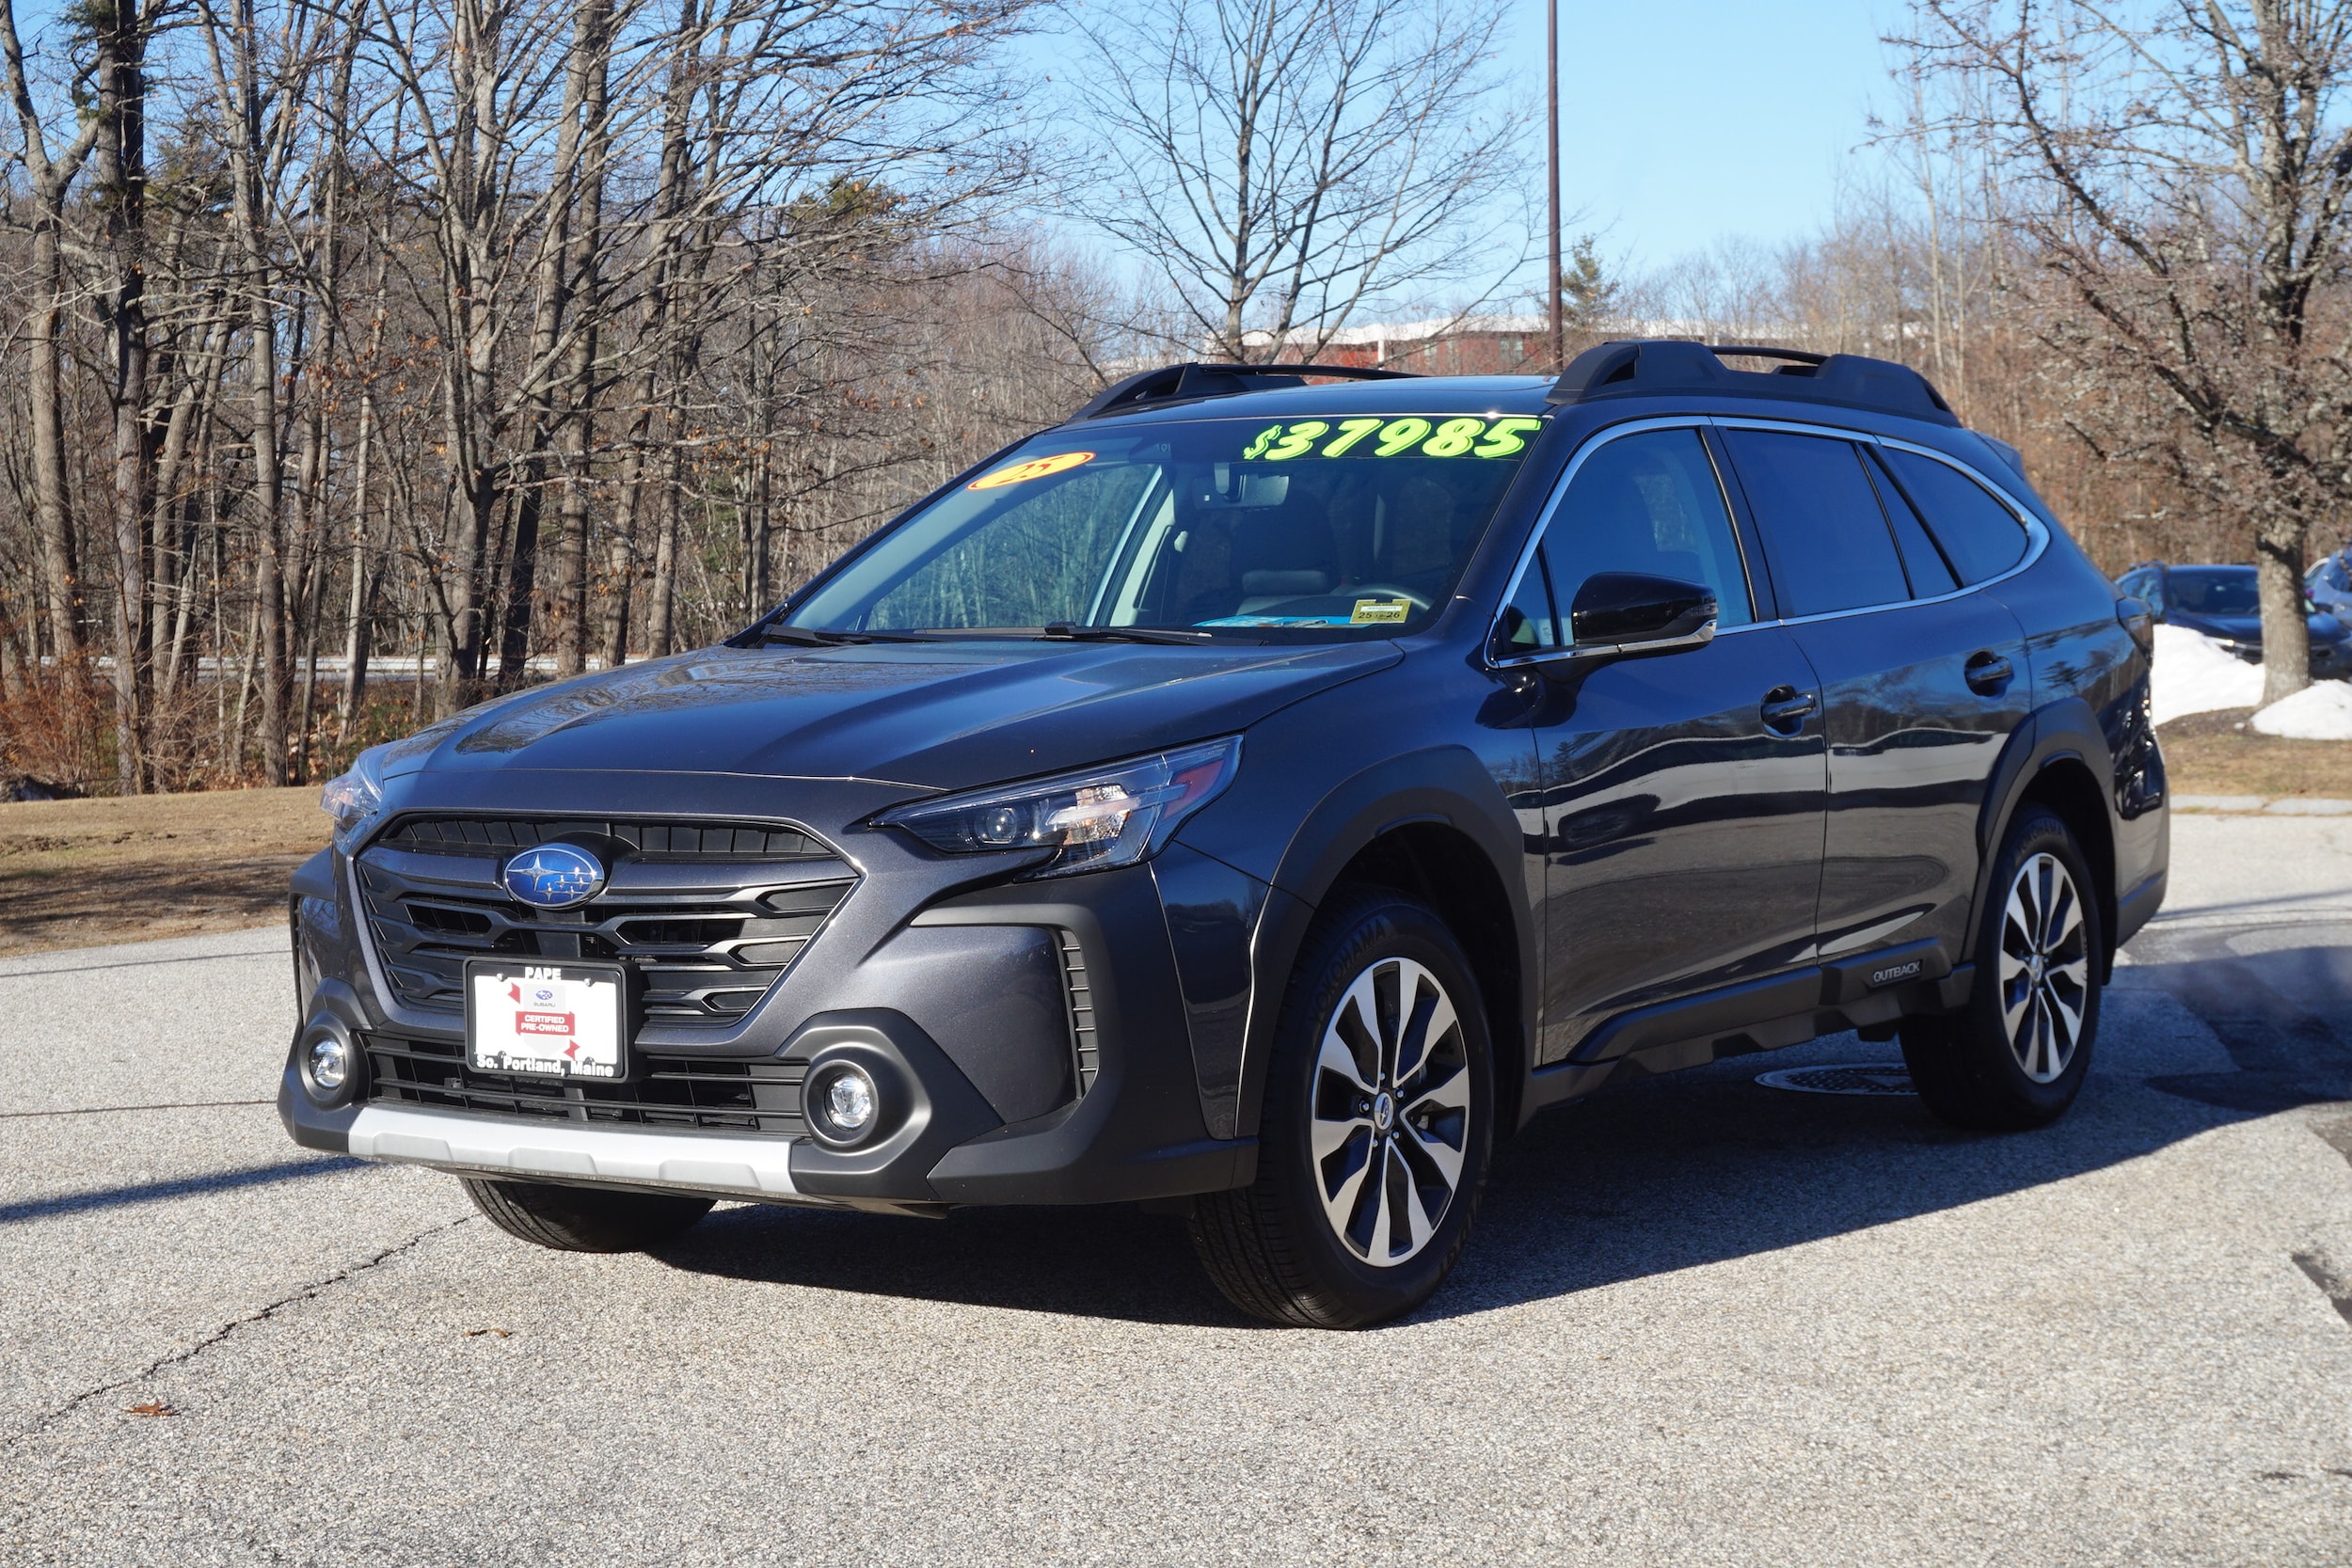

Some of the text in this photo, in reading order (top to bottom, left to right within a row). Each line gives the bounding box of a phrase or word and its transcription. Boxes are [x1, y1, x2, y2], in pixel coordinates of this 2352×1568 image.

[1243, 418, 1542, 460] $37985
[524, 966, 563, 981] PAPE
[1308, 917, 1387, 1025] YOKOHAMA
[1873, 961, 1920, 982] OUTBACK
[520, 1022, 569, 1033] PRE-OWNED
[524, 1014, 564, 1024] CERTIFIED
[476, 1053, 614, 1077] So. Portland, Maine
